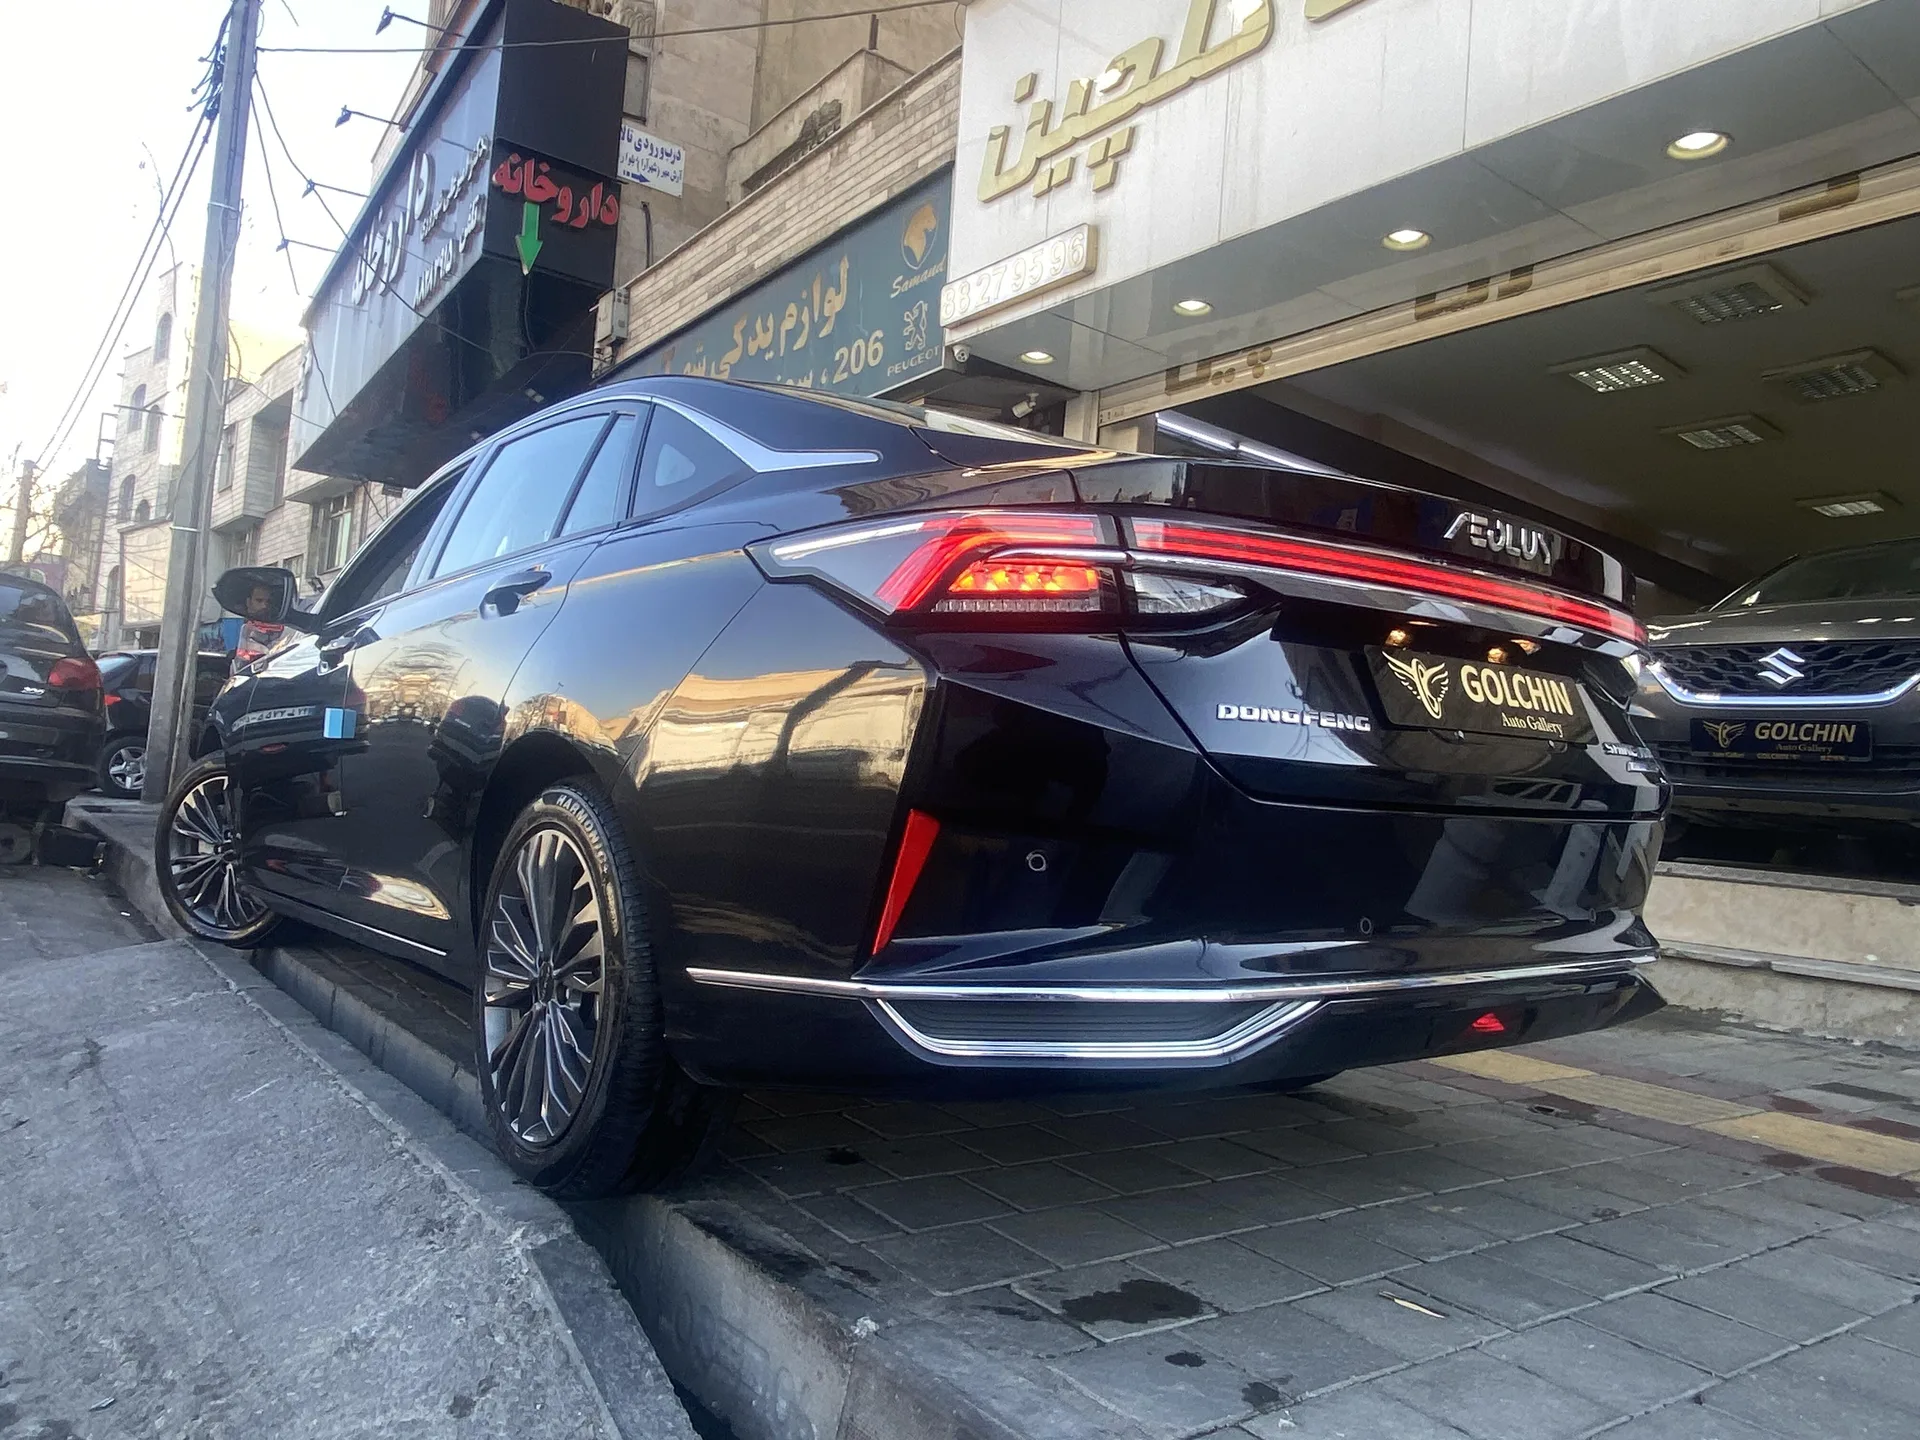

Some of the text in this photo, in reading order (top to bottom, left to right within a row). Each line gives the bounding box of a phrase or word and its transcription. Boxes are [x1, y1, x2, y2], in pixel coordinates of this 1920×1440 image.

[492, 152, 620, 229] داروخانه
[890, 253, 946, 298] Samand
[778, 254, 850, 357] لوازم
[887, 345, 941, 377] PEUGEOT
[1460, 664, 1574, 716] GOLCHIN
[1501, 712, 1564, 739] Auto Gallery
[1754, 722, 1857, 743] GOLCHIN
[1775, 743, 1833, 754] Auto Gallery
